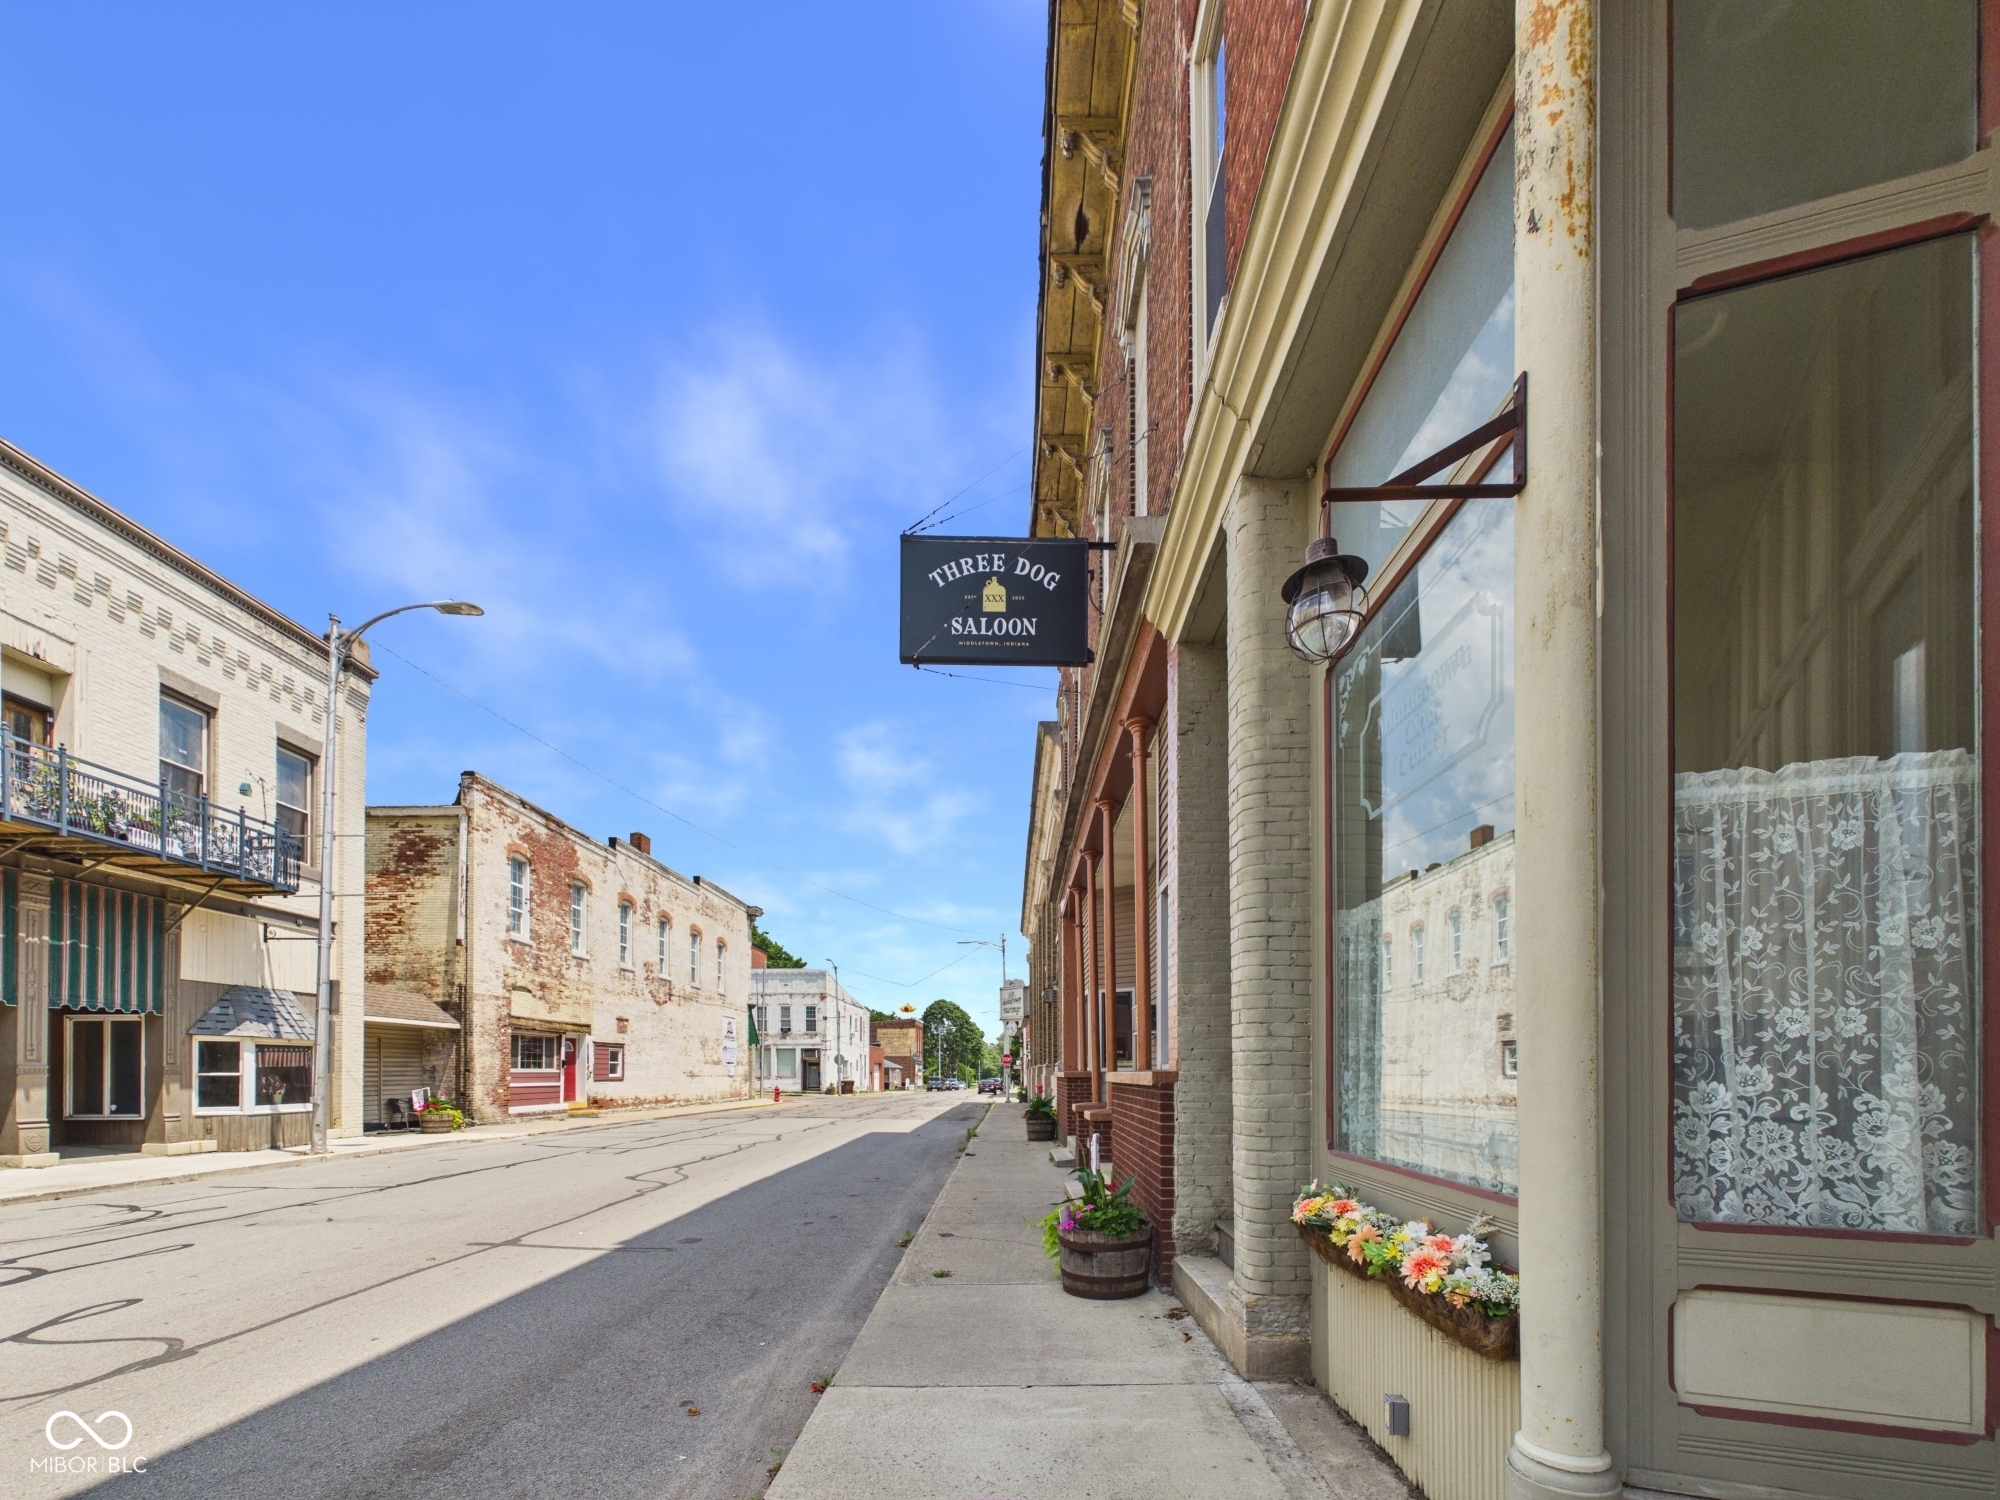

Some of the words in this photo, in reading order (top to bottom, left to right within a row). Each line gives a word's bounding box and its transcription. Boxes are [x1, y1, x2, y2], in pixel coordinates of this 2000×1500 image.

[928, 554, 1005, 588] THREE
[1014, 556, 1061, 591] DOG
[984, 594, 1005, 603] XXX
[951, 617, 1037, 635] SALOON
